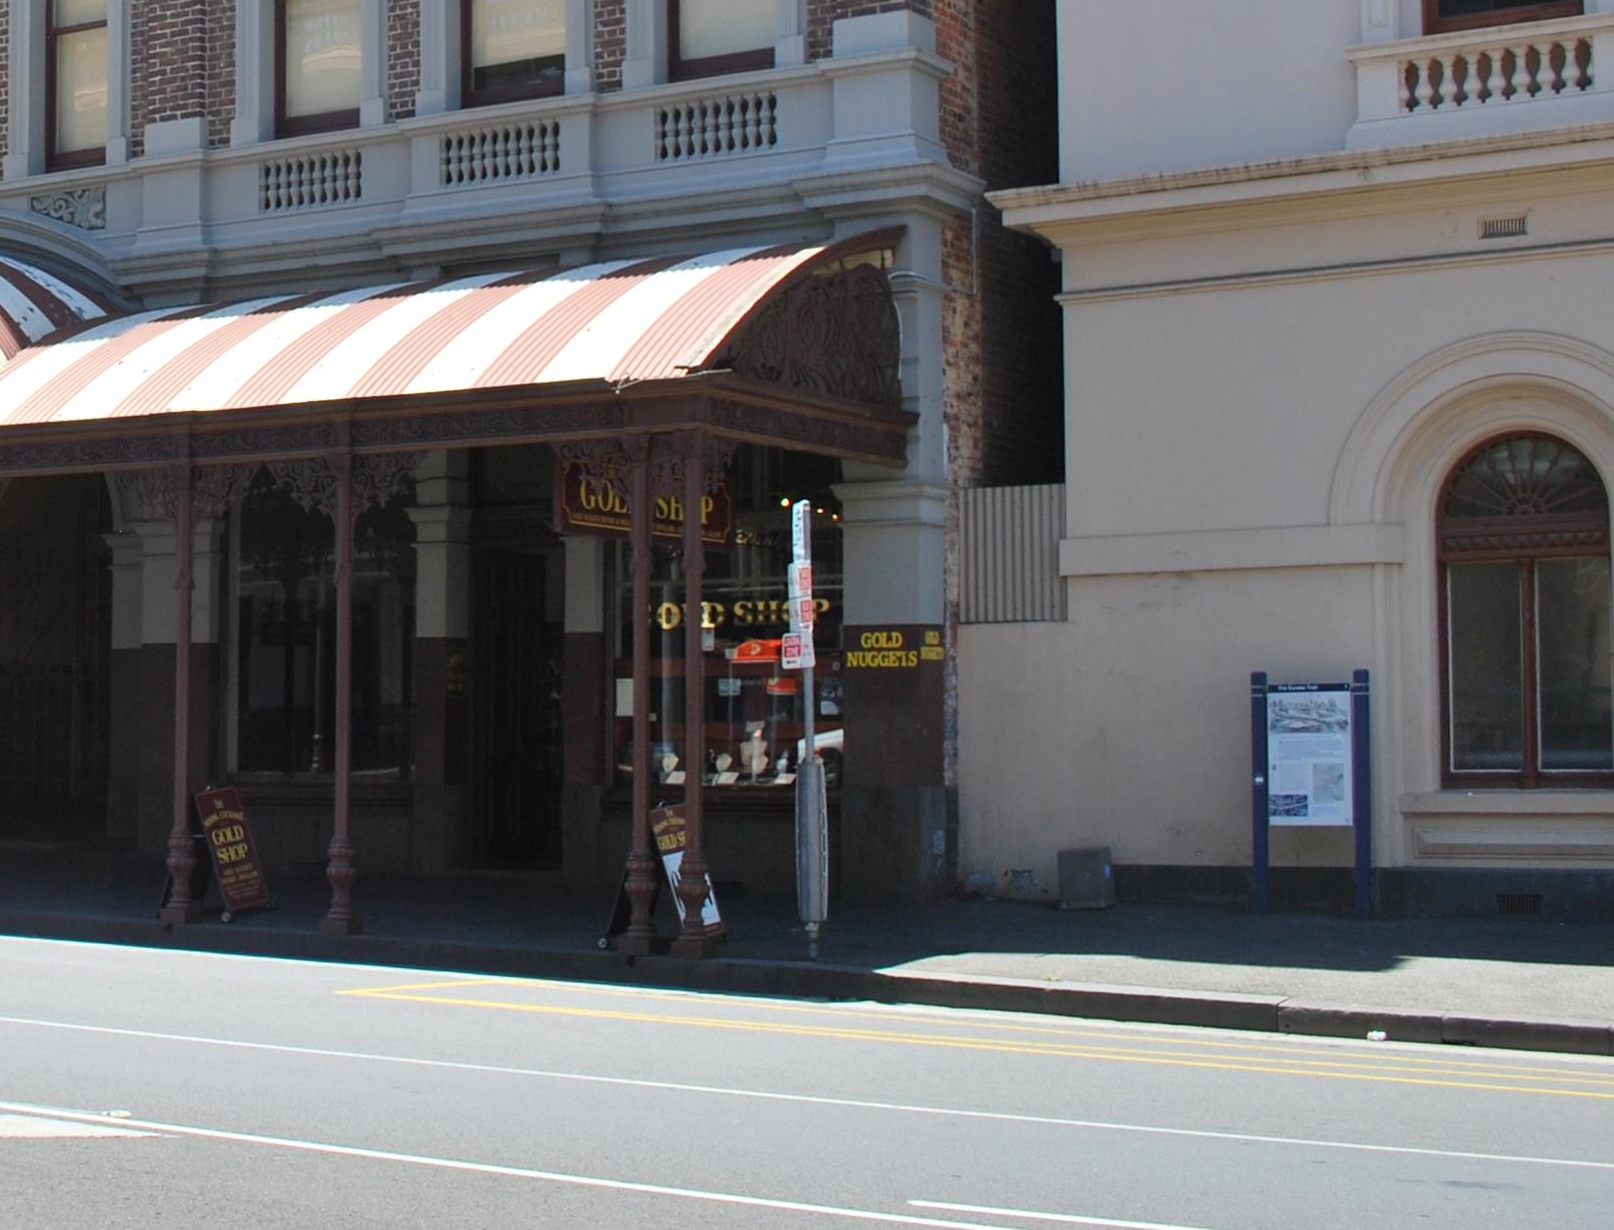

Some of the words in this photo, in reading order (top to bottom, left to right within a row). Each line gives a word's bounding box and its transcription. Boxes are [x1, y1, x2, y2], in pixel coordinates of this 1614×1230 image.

[579, 479, 632, 514] GOL
[655, 495, 715, 525] SHP
[648, 601, 725, 630] OD
[860, 632, 903, 648] GOLD
[847, 651, 919, 667] NUGGETS
[212, 825, 244, 846] GOLD
[216, 843, 248, 864] SHOP
